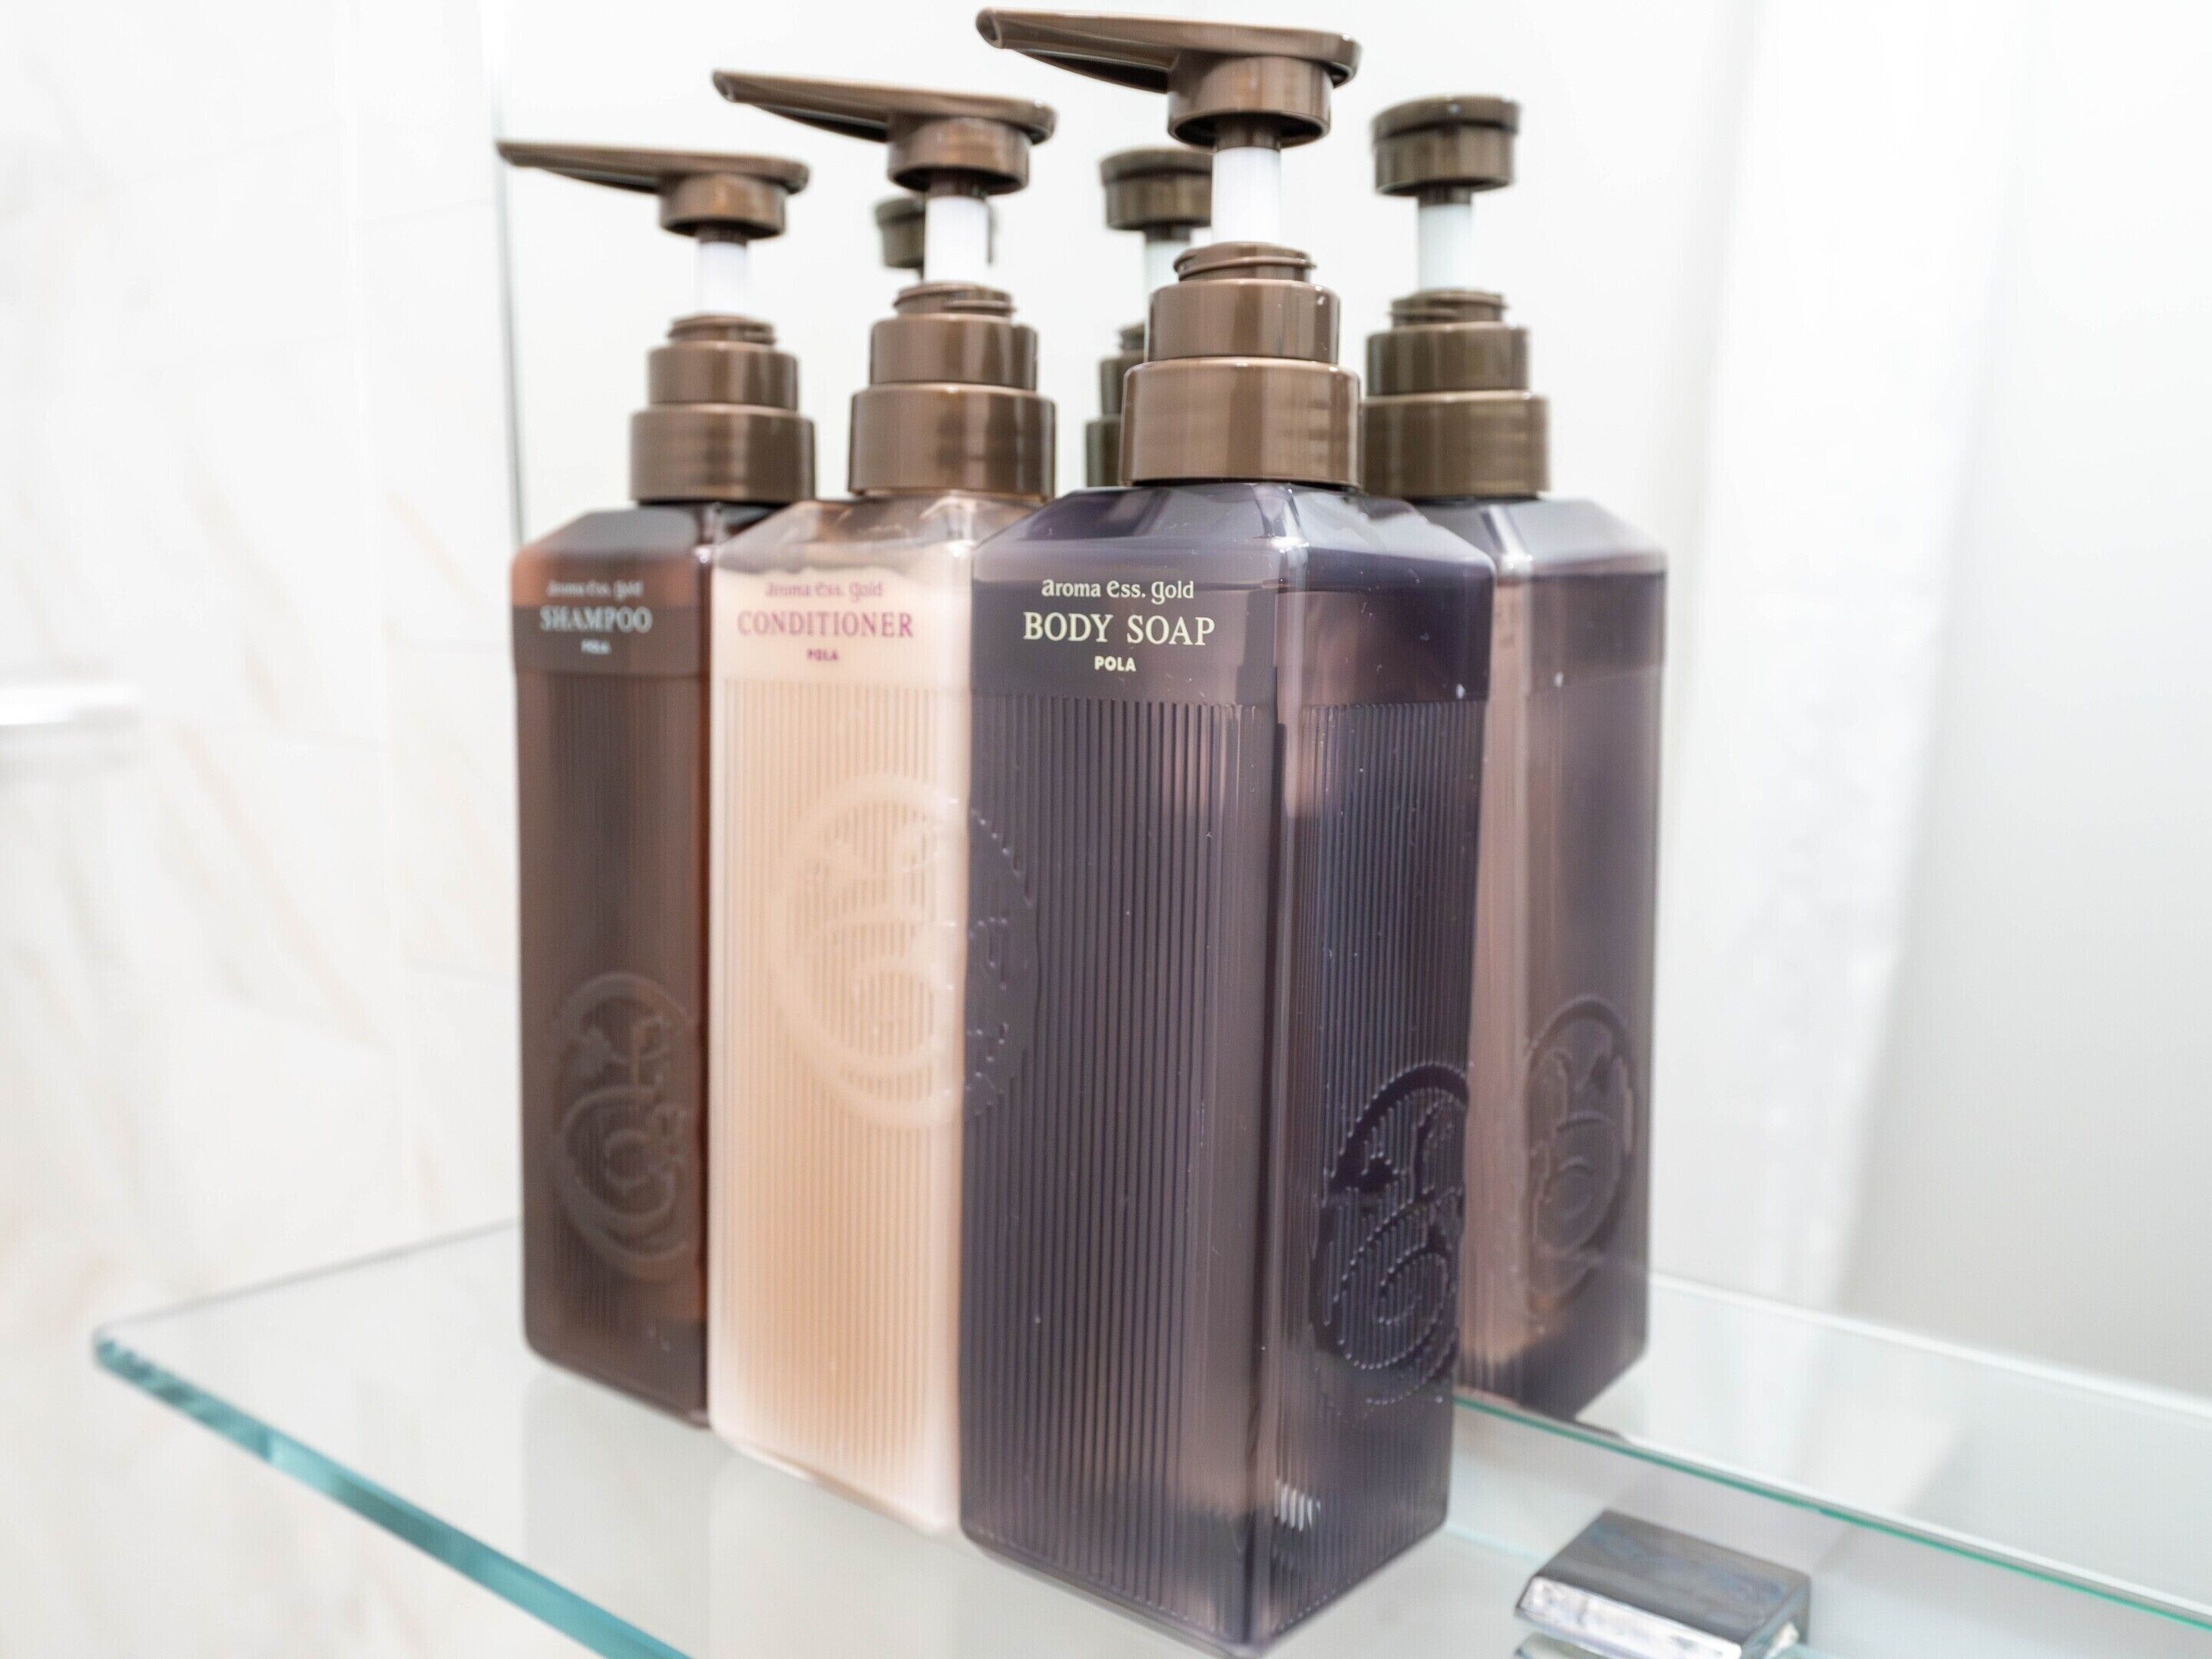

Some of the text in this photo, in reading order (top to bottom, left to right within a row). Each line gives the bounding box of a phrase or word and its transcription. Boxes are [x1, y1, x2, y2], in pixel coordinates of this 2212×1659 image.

[1041, 579, 1194, 604] aroma ess. gold
[540, 605, 653, 633] SHAMPOO
[737, 611, 913, 637] CONDITIONER
[1023, 612, 1215, 645] BODY SOAP
[1094, 656, 1136, 672] POLA
